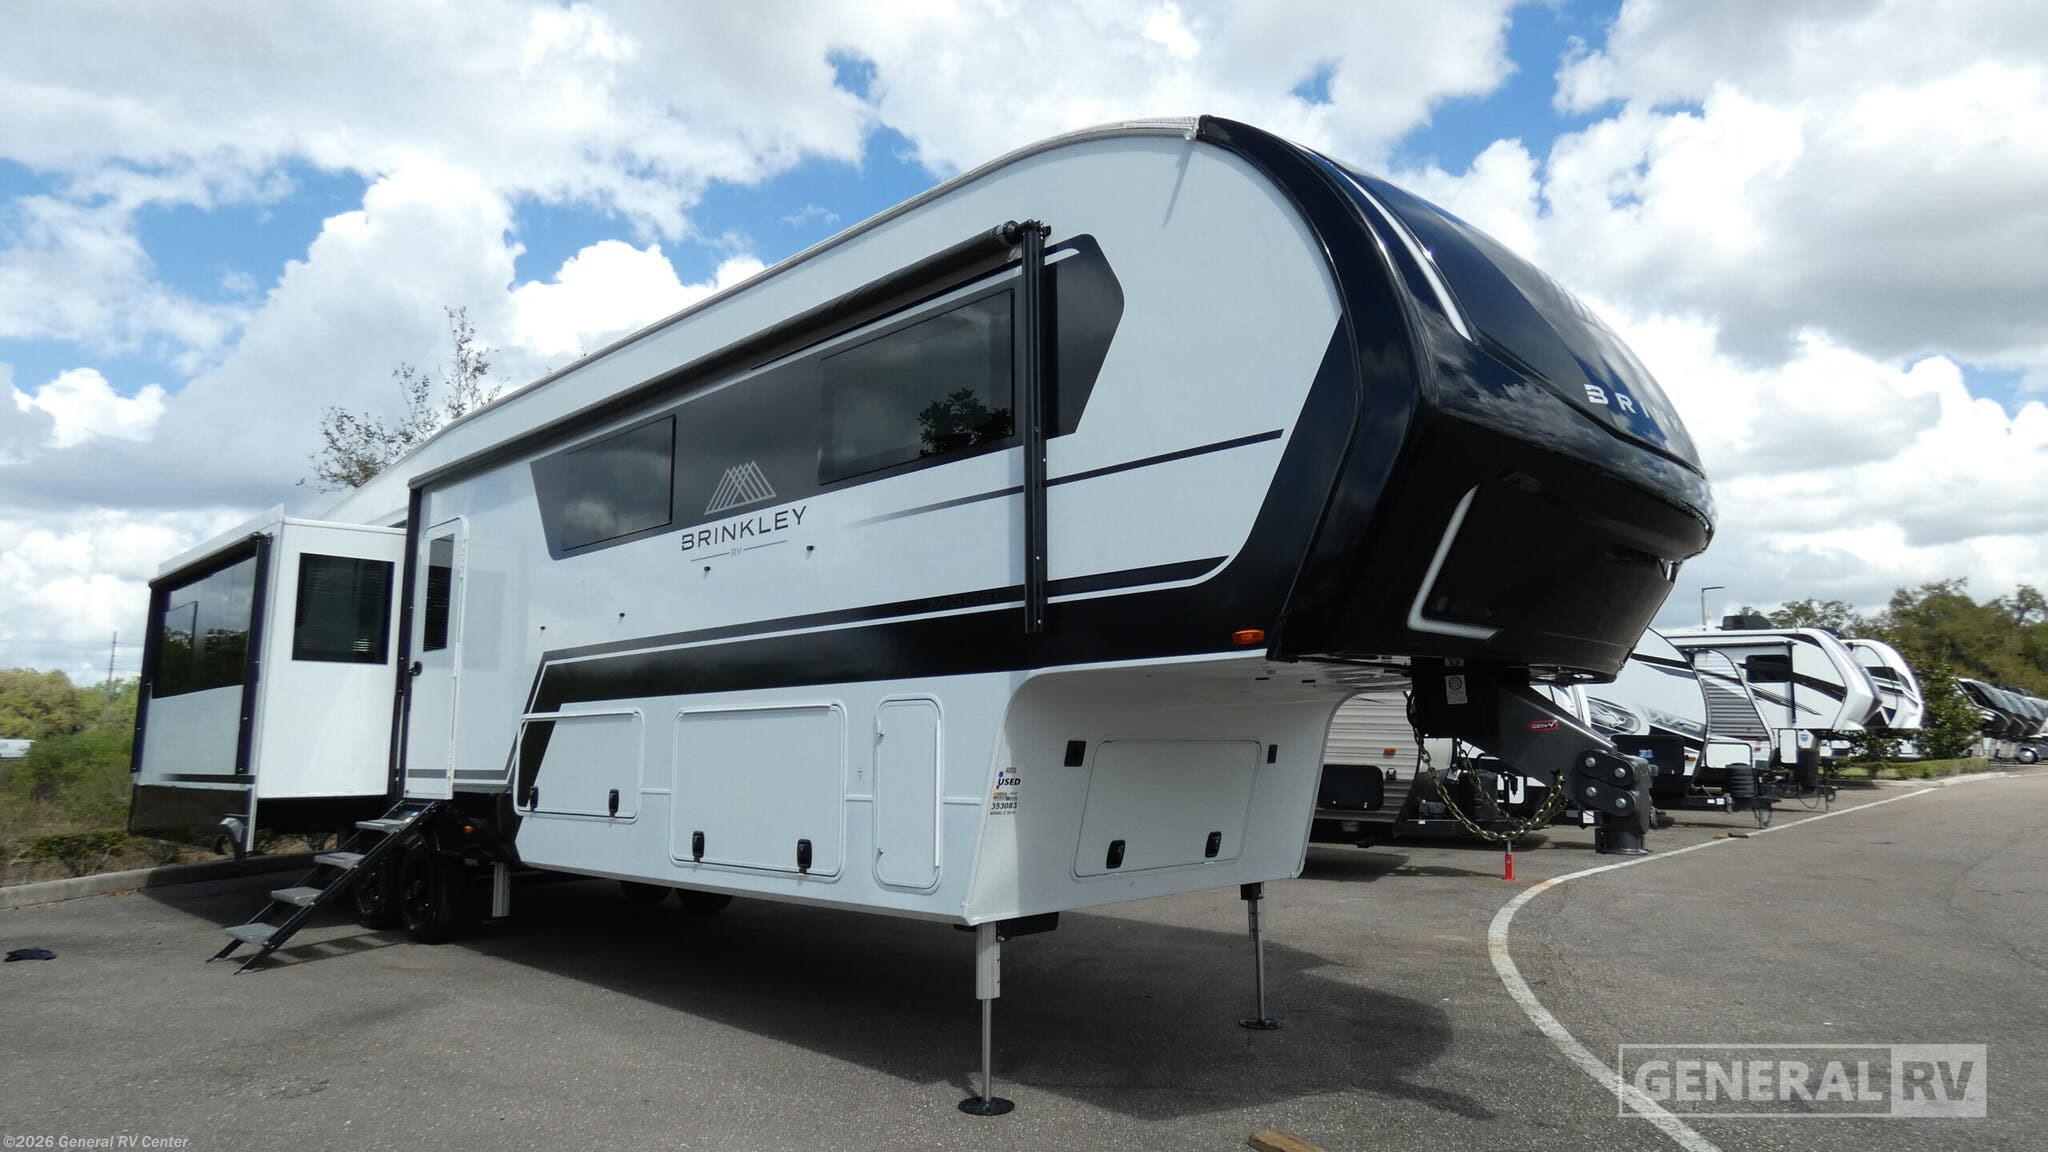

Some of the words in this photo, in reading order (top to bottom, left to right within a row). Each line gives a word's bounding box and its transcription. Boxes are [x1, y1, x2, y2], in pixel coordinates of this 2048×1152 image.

[681, 505, 807, 551] BRINKLEY
[730, 547, 743, 557] RV
[998, 778, 1021, 786] USED
